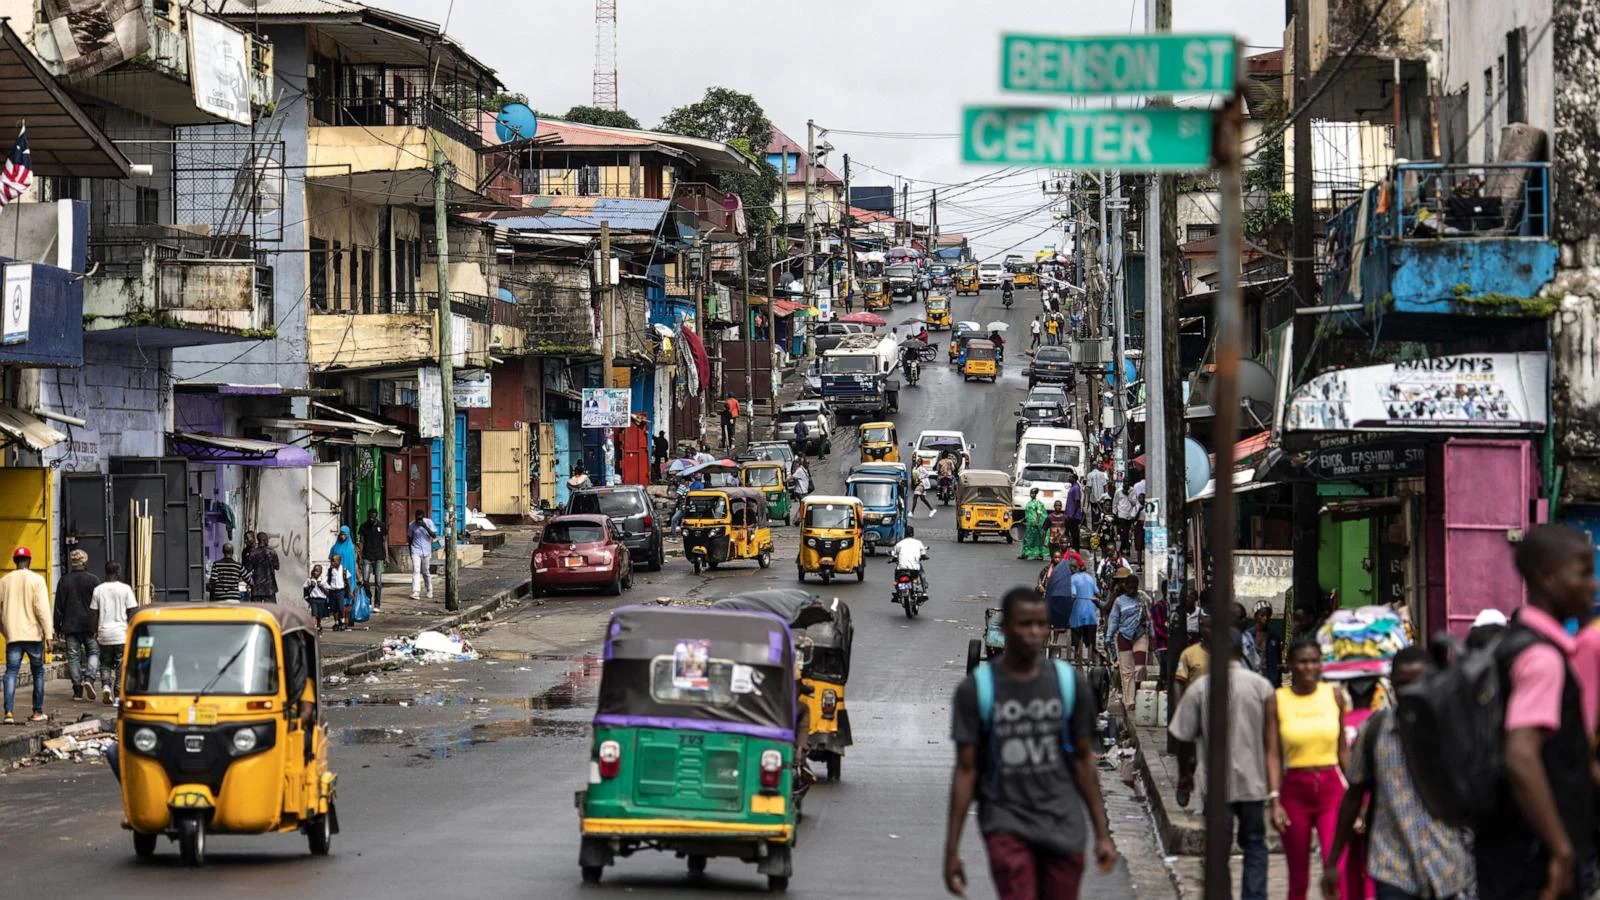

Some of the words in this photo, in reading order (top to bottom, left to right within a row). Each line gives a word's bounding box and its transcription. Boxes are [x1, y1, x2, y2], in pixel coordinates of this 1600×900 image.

[1009, 41, 1160, 89] BENSON
[1182, 40, 1233, 88] ST
[971, 112, 1153, 162] CENTER
[1351, 449, 1395, 465] FASHION
[1238, 556, 1276, 567] LAND
[1282, 559, 1294, 568] FO
[1245, 566, 1287, 577] LEASE
[680, 735, 705, 745] TVS
